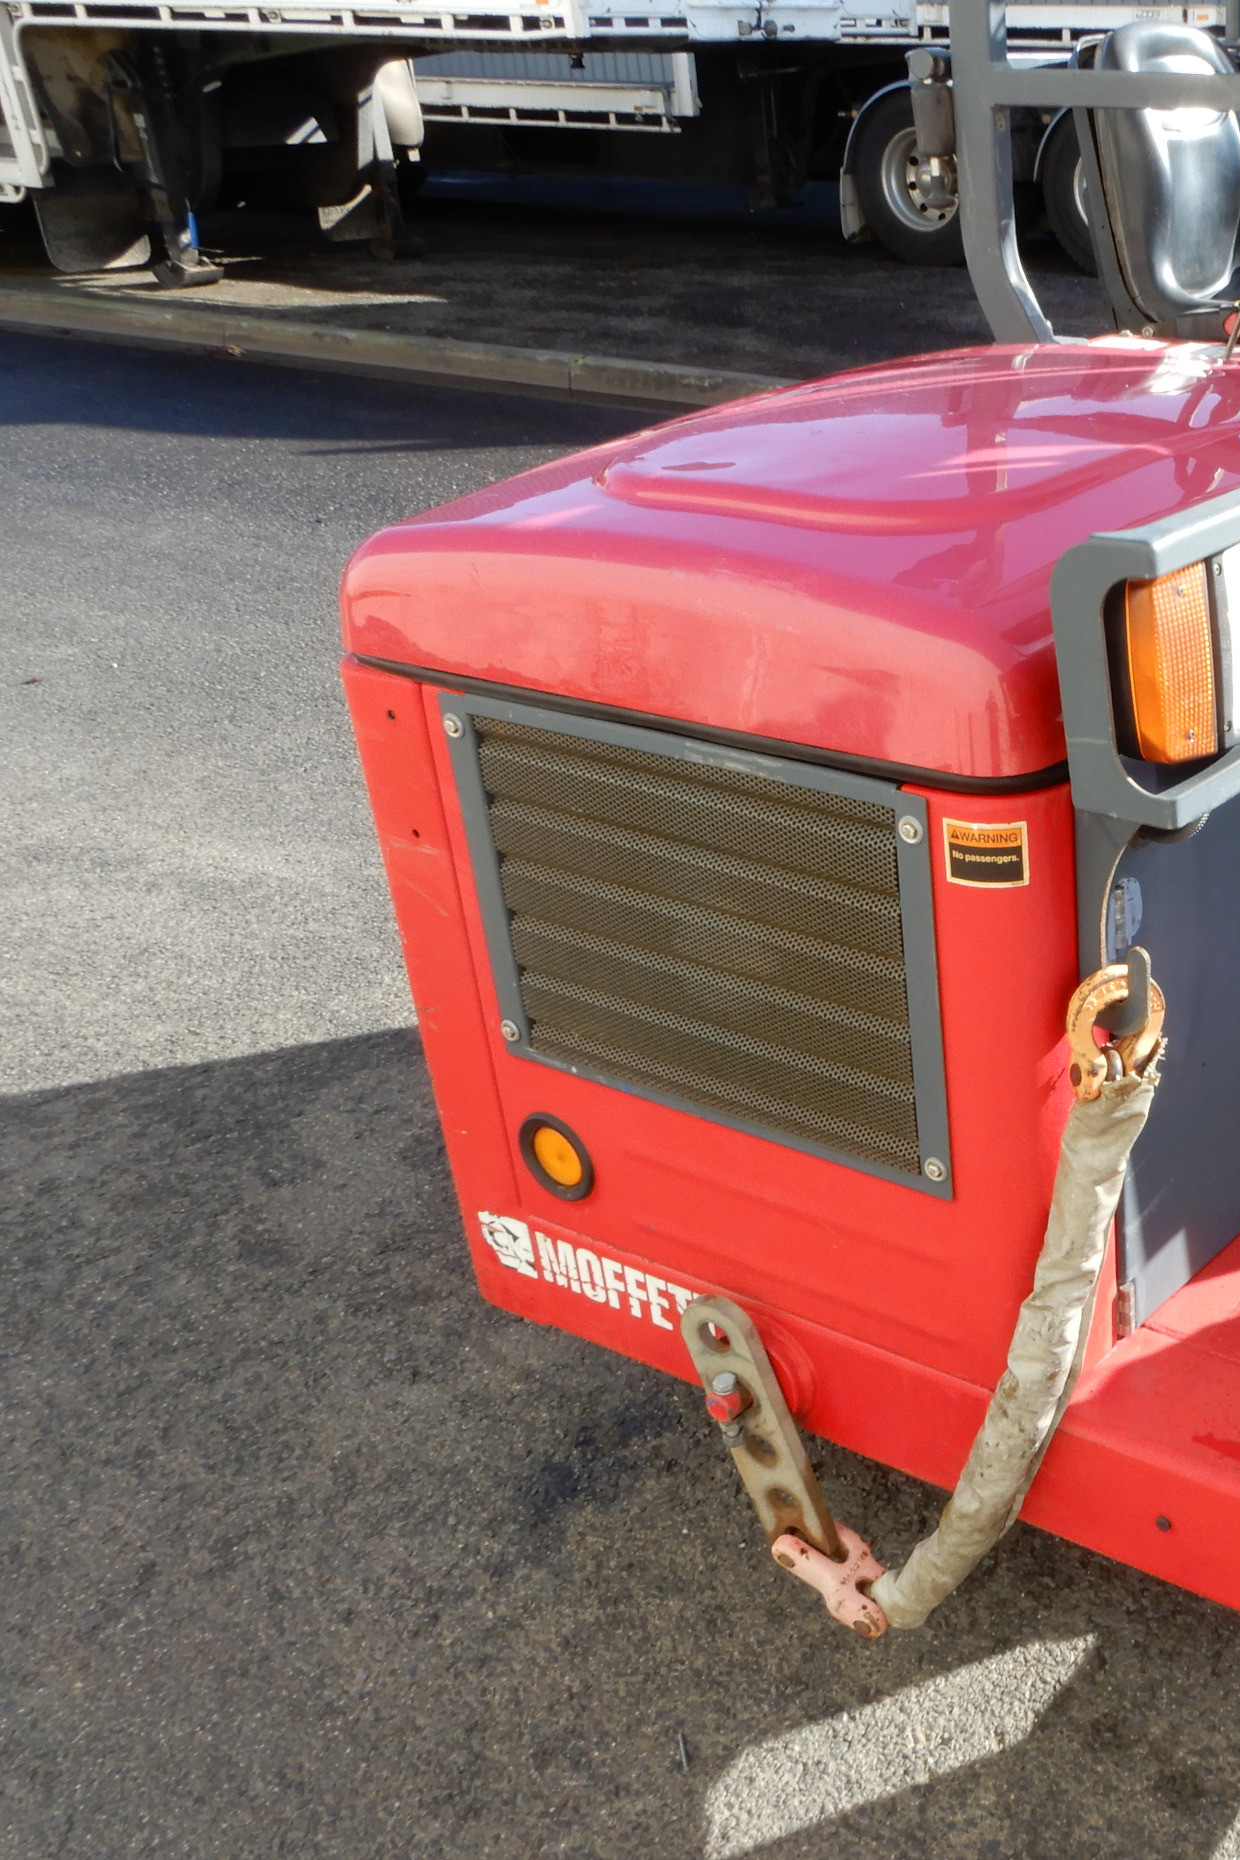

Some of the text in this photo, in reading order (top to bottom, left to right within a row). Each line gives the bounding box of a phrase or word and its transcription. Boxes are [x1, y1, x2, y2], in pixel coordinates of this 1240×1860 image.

[959, 831, 1018, 843] WARNING
[952, 850, 1020, 865] No passengers.
[534, 1231, 716, 1337] MOFFET
